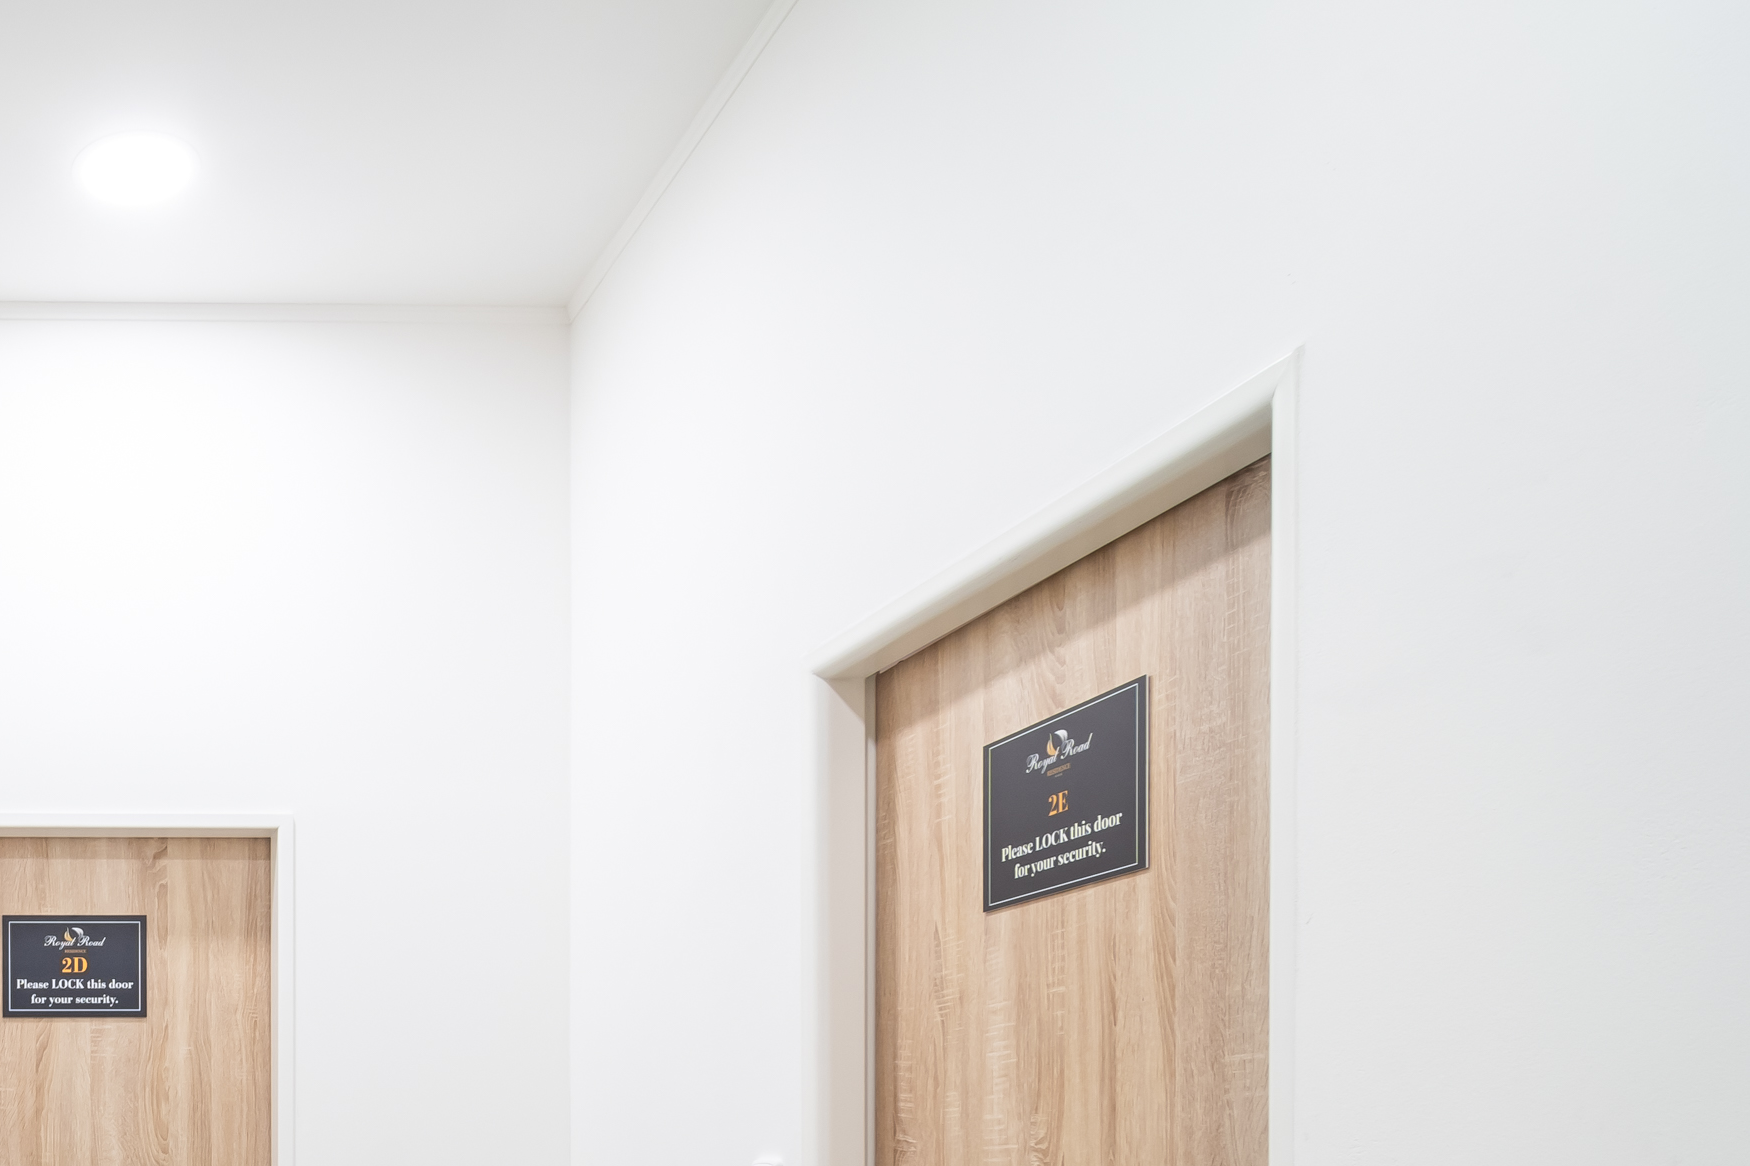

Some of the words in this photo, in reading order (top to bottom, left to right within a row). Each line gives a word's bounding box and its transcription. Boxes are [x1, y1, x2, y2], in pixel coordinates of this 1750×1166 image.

[1025, 746, 1060, 774] Royal
[1060, 732, 1093, 760] Road
[1048, 790, 1069, 817] 2E
[1001, 844, 1034, 863] Please
[1035, 827, 1069, 852] LOCK
[1069, 820, 1092, 841] this
[1093, 812, 1123, 833] door
[1014, 863, 1031, 879] for
[1030, 856, 1057, 877] your
[1057, 840, 1107, 866] security.
[44, 935, 76, 950] Royal
[77, 935, 106, 946] Road
[61, 956, 88, 974] 2D
[16, 978, 50, 990] Please
[51, 978, 85, 990] LOCK
[86, 978, 107, 990] this
[108, 978, 134, 990] door
[30, 993, 47, 1005] for
[48, 995, 74, 1008] your
[75, 993, 119, 1008] security.
